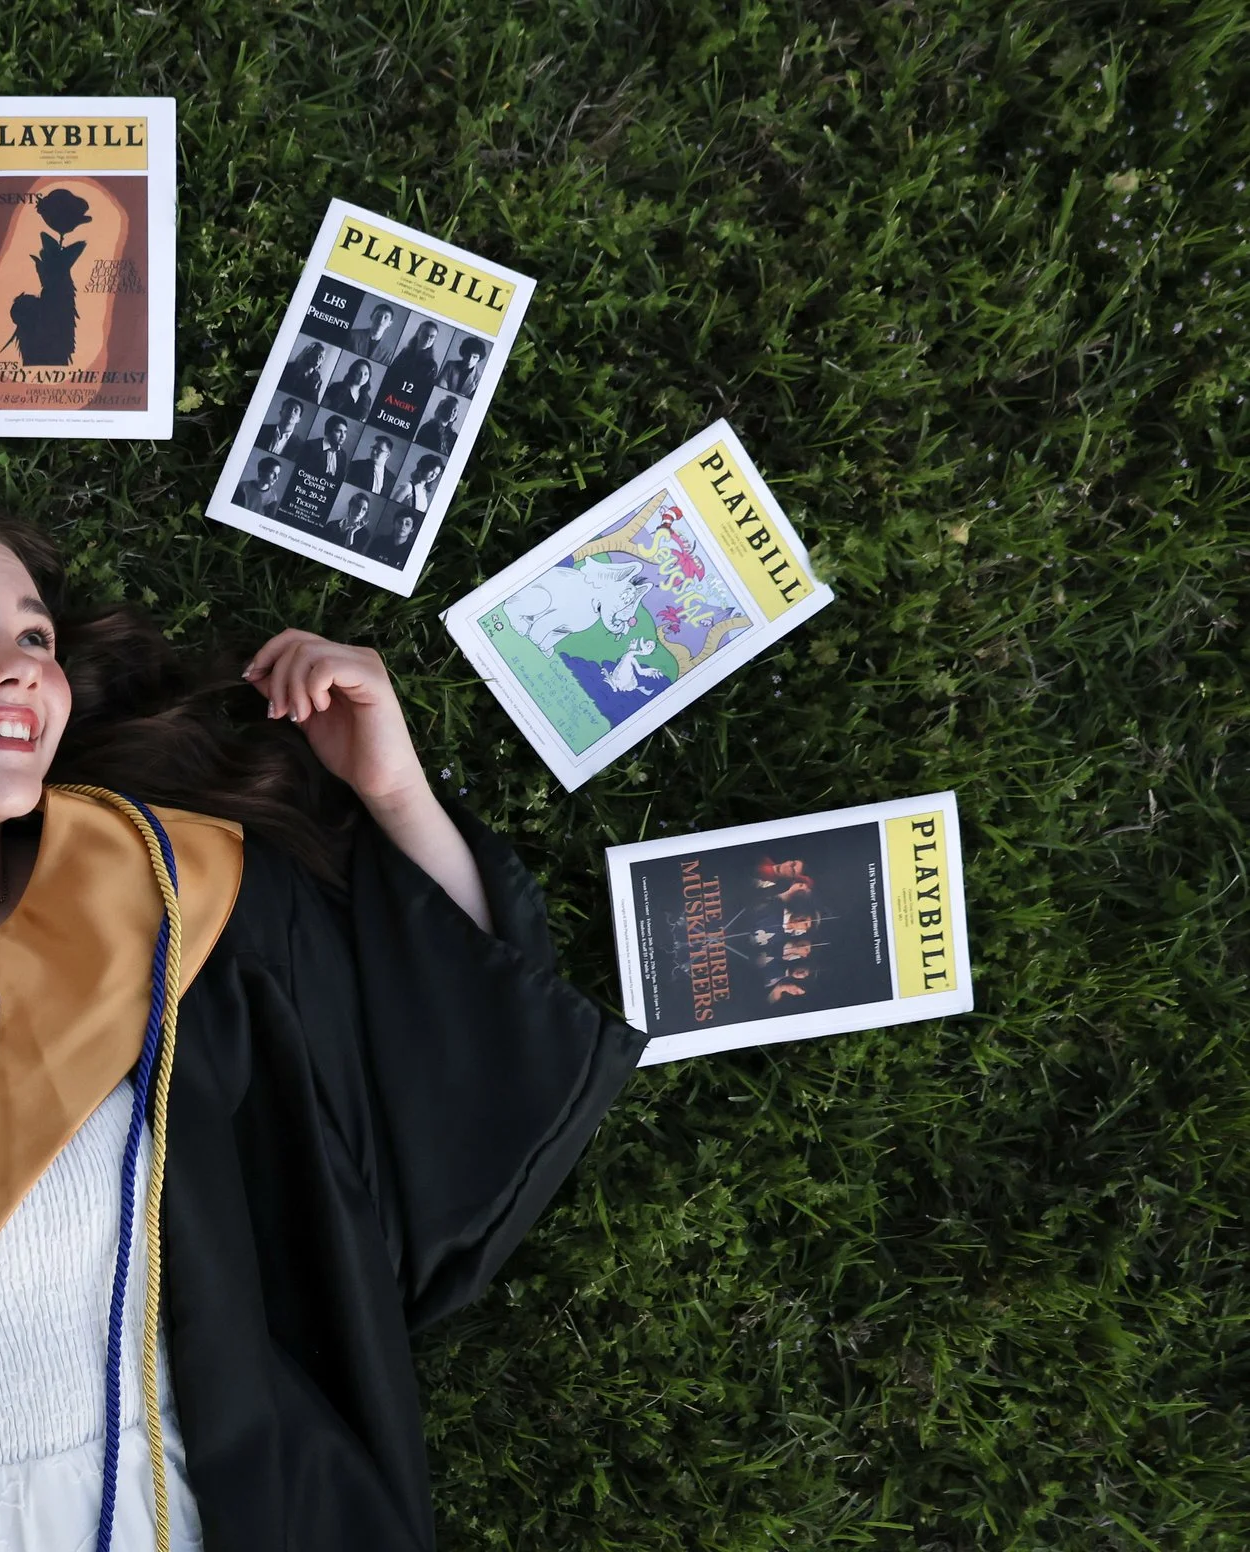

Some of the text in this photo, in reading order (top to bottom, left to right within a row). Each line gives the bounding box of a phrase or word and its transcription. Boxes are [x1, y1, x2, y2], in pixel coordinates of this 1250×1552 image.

[339, 226, 503, 311] PLAYBILL
[322, 292, 346, 308] LHS
[306, 304, 349, 329] PRESENTS
[31, 370, 65, 383] AND
[68, 370, 99, 383] THE
[101, 371, 146, 384] BEAST
[401, 381, 413, 393] 12
[384, 394, 416, 412] ANGRY
[376, 409, 410, 429] JURORS
[698, 449, 801, 603] PLAYBILL
[911, 817, 946, 989] PLAYBILL
[680, 860, 713, 1021] MUSKETEERS
[702, 875, 729, 1001] THE THREE
